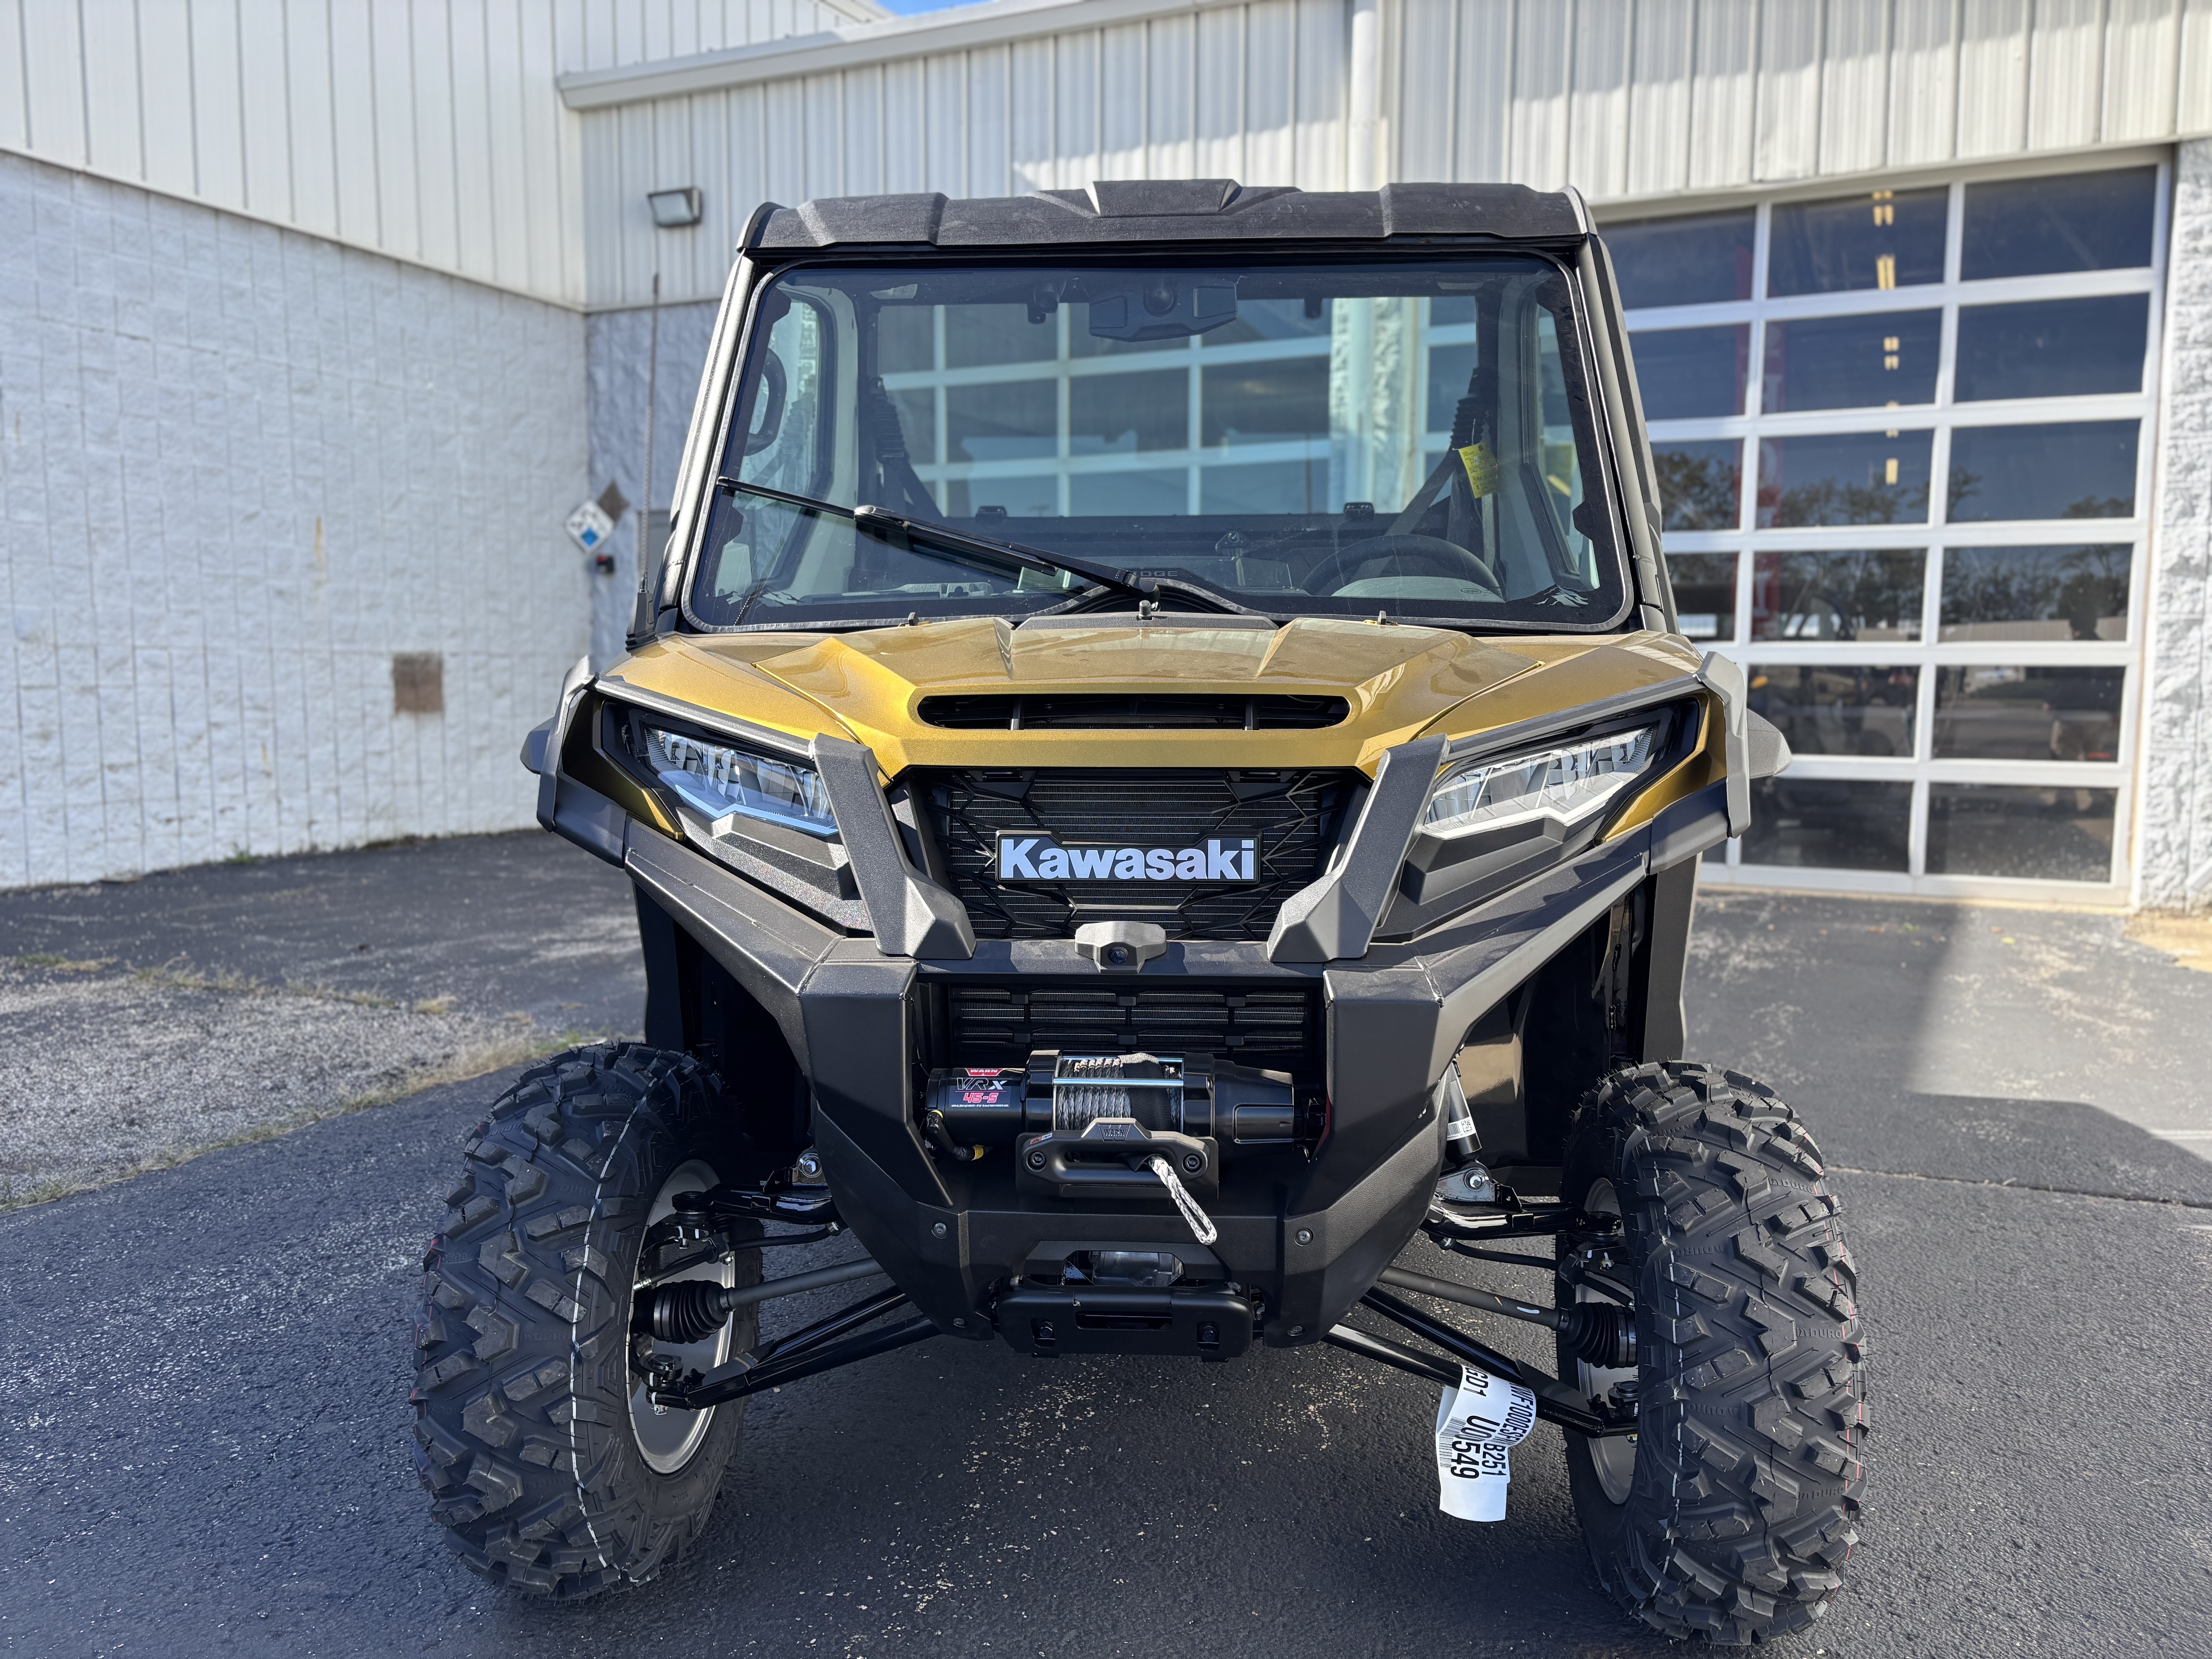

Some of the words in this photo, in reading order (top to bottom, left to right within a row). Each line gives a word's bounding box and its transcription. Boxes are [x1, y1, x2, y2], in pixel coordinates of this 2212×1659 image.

[1001, 839, 1254, 881] Kawasaki
[957, 1077, 1008, 1090] VRX
[963, 1092, 999, 1103] 45-S
[1781, 1179, 1814, 1194] DURO
[1675, 1245, 1714, 1257] DURO
[1809, 1328, 1842, 1339] DURO
[1686, 1403, 1727, 1416] DURO
